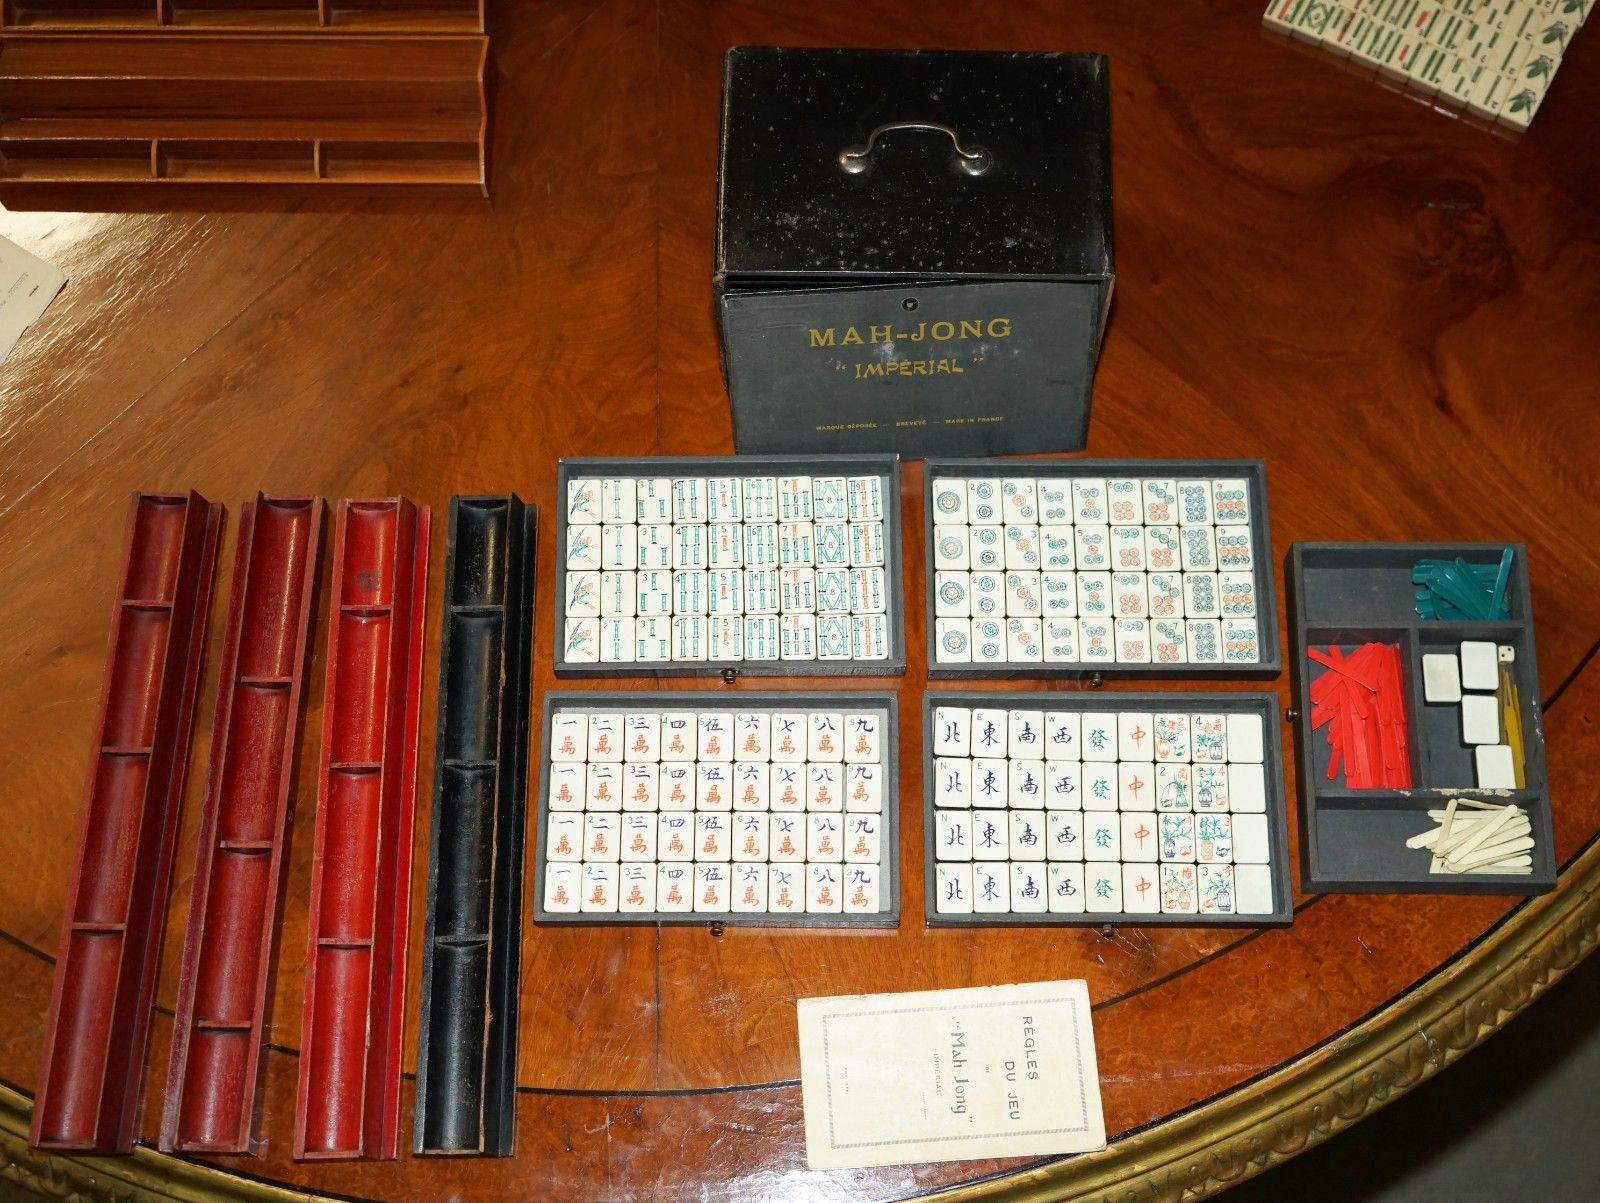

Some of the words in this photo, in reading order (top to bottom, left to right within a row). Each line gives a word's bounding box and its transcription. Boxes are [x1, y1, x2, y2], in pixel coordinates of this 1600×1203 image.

[809, 318, 1013, 347] MAH-JONG
[603, 481, 608, 490] 2
[638, 480, 644, 488] 3
[720, 481, 725, 489] 5
[1027, 485, 1032, 493] 3
[1041, 486, 1046, 494] 4
[641, 528, 647, 536] 3
[721, 525, 727, 533] 5
[1045, 533, 1051, 542] 4
[643, 574, 647, 582] 3
[721, 573, 726, 581] 5
[1043, 576, 1051, 584] 4
[1224, 576, 1230, 584] 9
[641, 620, 645, 628] 3
[723, 618, 729, 626] 5
[1048, 622, 1054, 630] 4
[939, 711, 944, 719] N
[1015, 712, 1020, 720] S
[592, 717, 597, 725] 2
[661, 716, 668, 727] 4
[944, 721, 960, 742] 北
[981, 720, 1000, 746] 東
[1018, 721, 1036, 744] 南
[1052, 727, 1072, 744] 西
[1130, 724, 1147, 750] 中
[591, 764, 597, 772] 2
[661, 766, 668, 774] 4
[940, 762, 946, 770] N
[1017, 762, 1022, 771] S
[946, 771, 962, 792] 北
[980, 768, 1000, 795] 東
[1020, 772, 1038, 795] 南
[1054, 776, 1075, 793] 西
[1128, 775, 1145, 800] 中
[628, 816, 633, 824] 3
[942, 814, 947, 822] N
[1015, 813, 1021, 822] S
[947, 824, 964, 846] 北
[980, 822, 1001, 848] 東
[1019, 822, 1037, 845] 南
[1055, 825, 1077, 844] 西
[1133, 823, 1151, 850] 中
[587, 867, 593, 875] 2
[625, 868, 630, 876] 3
[659, 866, 666, 874] 4
[939, 868, 945, 876] N
[1017, 867, 1023, 875] S
[1051, 867, 1059, 875] W
[946, 878, 963, 900] 北
[981, 874, 1000, 901] 東
[1021, 875, 1040, 899] 南
[1056, 879, 1077, 896] 西
[1135, 875, 1152, 902] 中
[1004, 1061, 1016, 1081] DU
[1008, 1093, 1020, 1120] JEU
